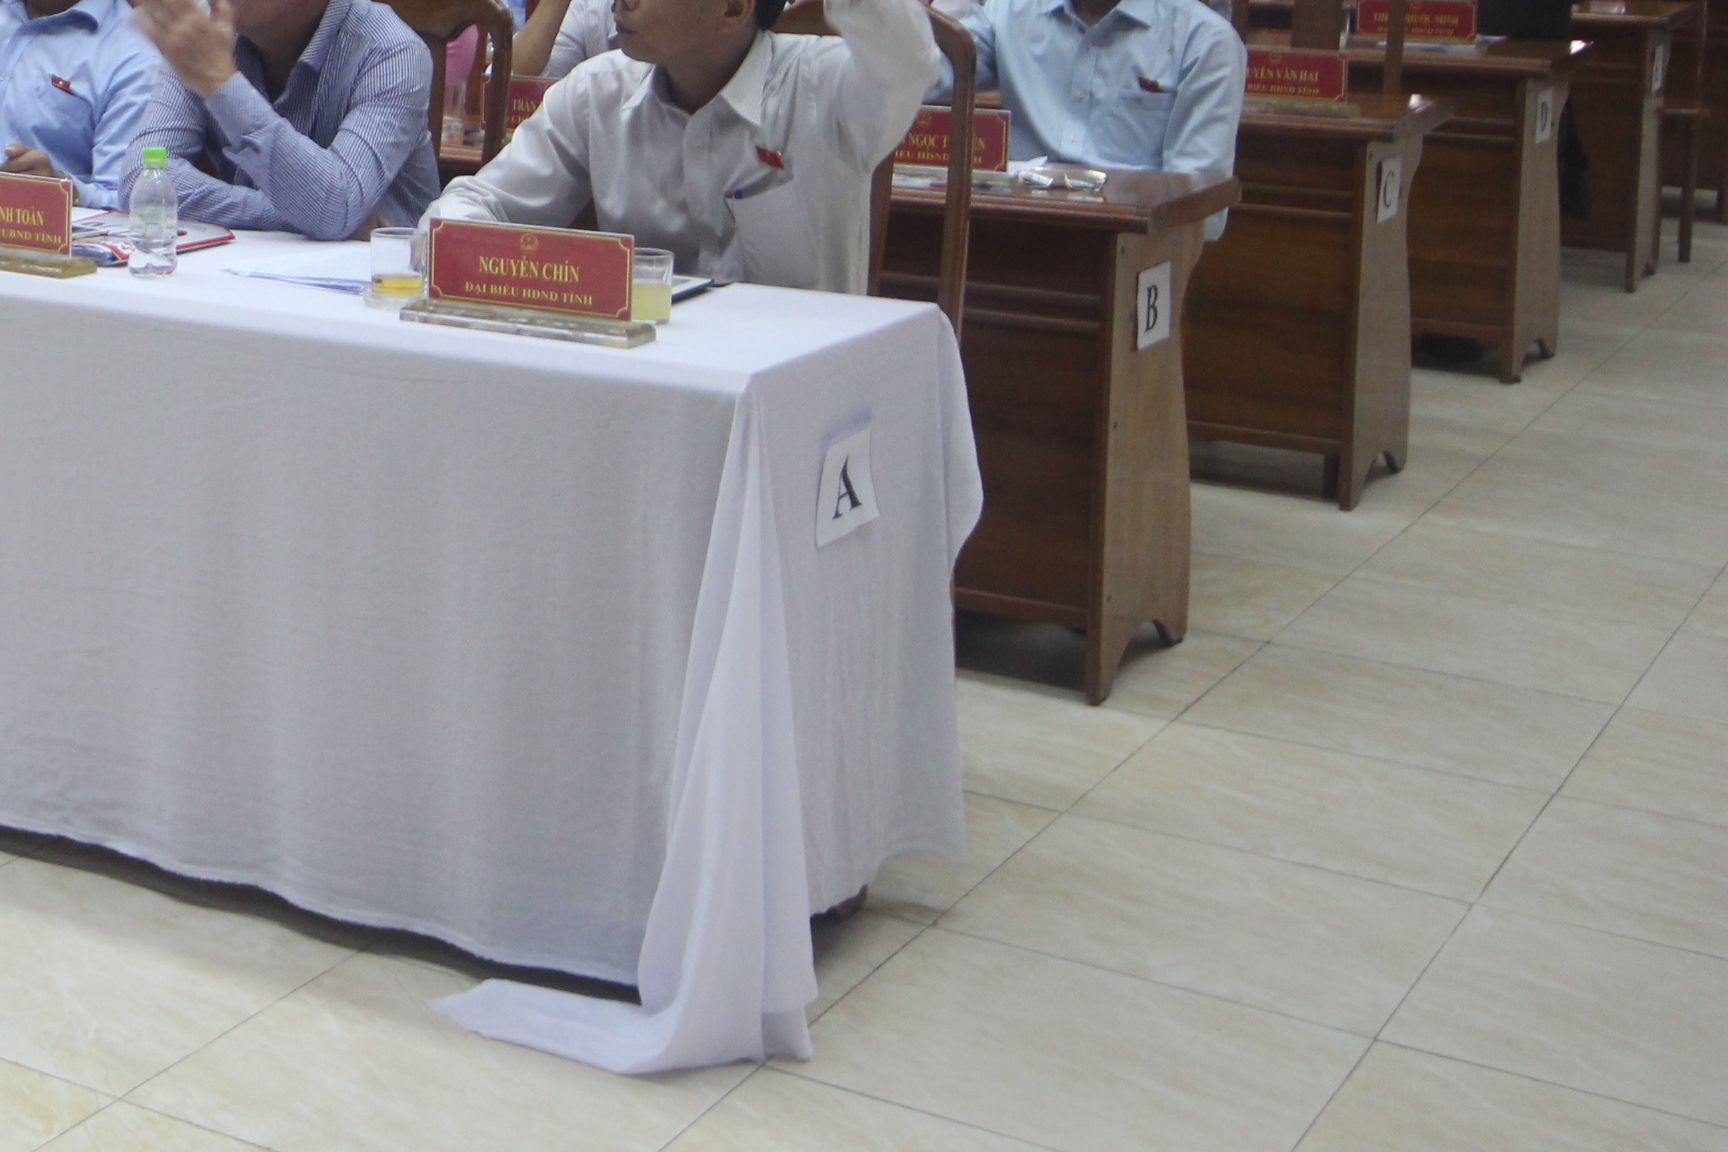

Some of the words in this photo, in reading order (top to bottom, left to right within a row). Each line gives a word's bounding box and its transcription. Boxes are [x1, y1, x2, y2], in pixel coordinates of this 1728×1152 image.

[1383, 170, 1395, 209] C
[2, 227, 33, 241] UBND
[542, 259, 580, 283] CHÍN
[1144, 284, 1159, 333] B
[831, 455, 863, 521] A
